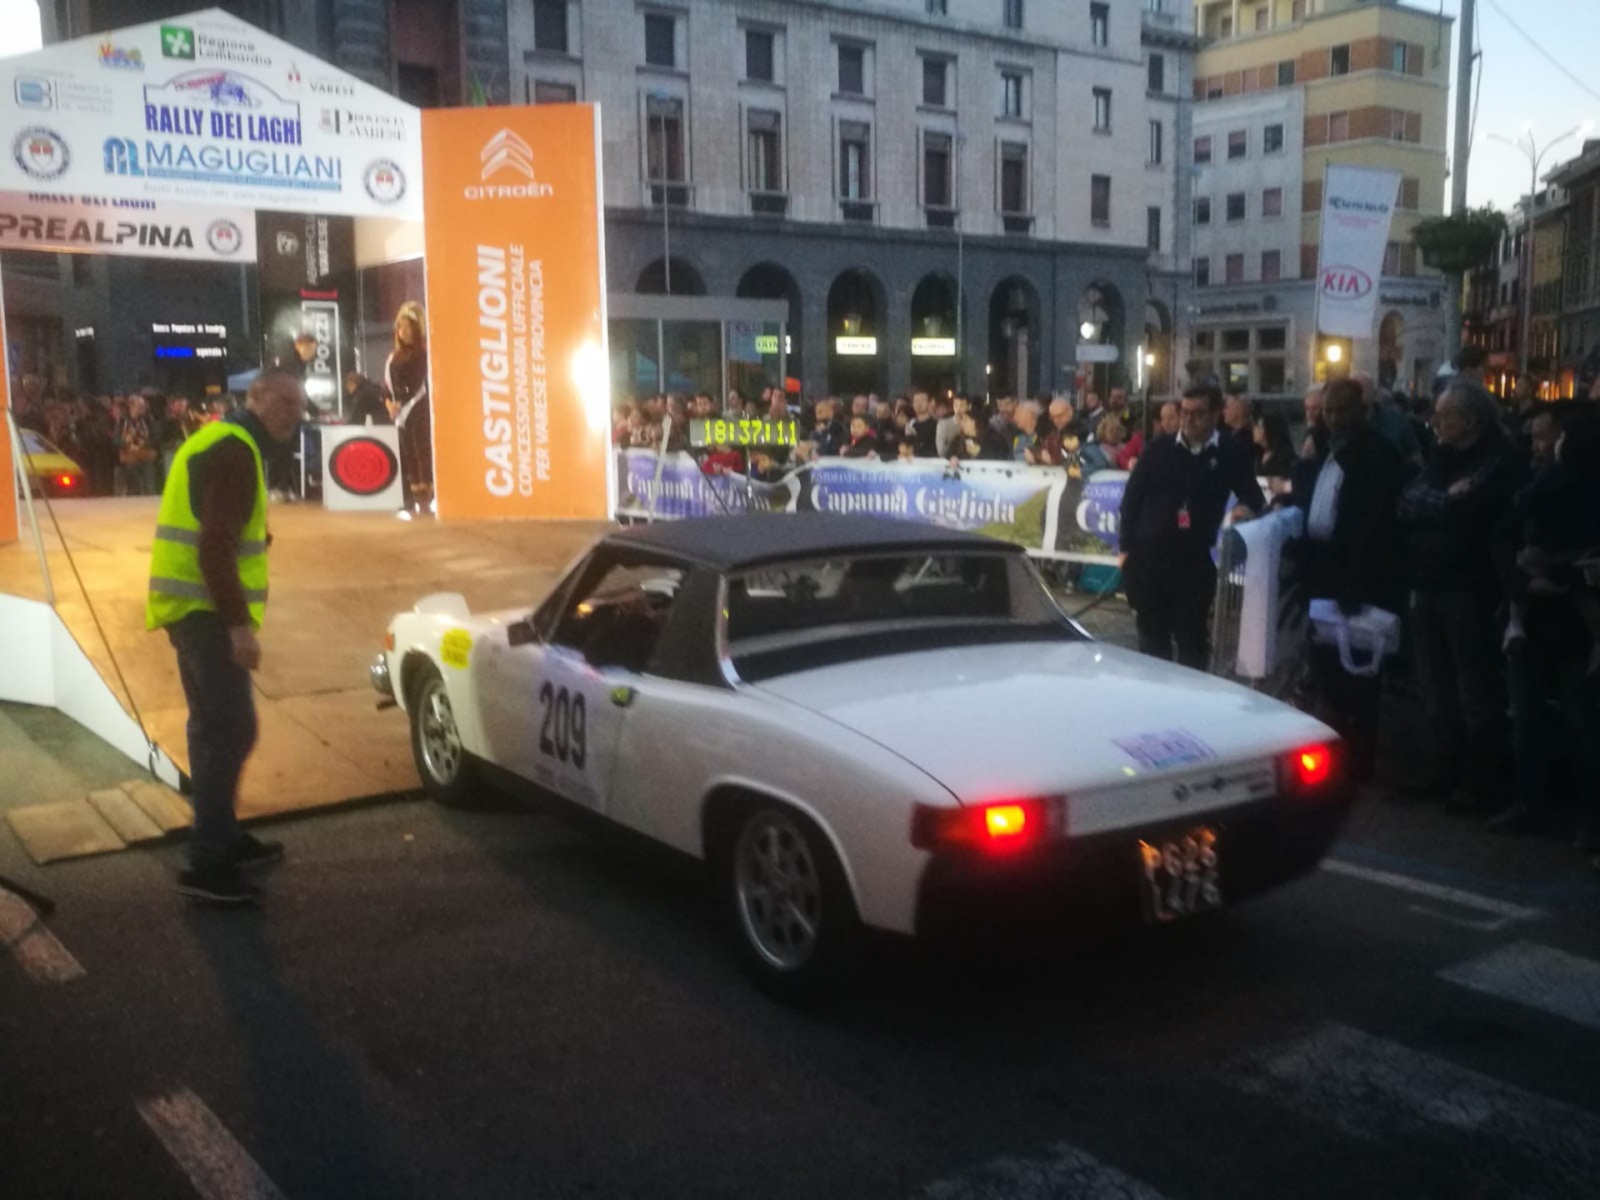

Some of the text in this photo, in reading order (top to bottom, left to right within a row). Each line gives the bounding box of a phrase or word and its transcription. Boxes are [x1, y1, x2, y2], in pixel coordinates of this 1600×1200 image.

[199, 35, 255, 51] Regione
[200, 50, 271, 65] Lombardia
[145, 103, 302, 145] RALLY DEI LAGHI
[146, 140, 342, 179] MAGUGLIANI
[0, 214, 194, 248] PREALPINA
[1324, 273, 1360, 293] KIA
[477, 245, 514, 497] CASTIGLIONI
[510, 244, 533, 496] CONCESSIONARIA UFFICIALE
[530, 260, 550, 480] PER VARESE E PROVINCIA
[916, 486, 1015, 524] Gigliola
[540, 681, 586, 769] 209
